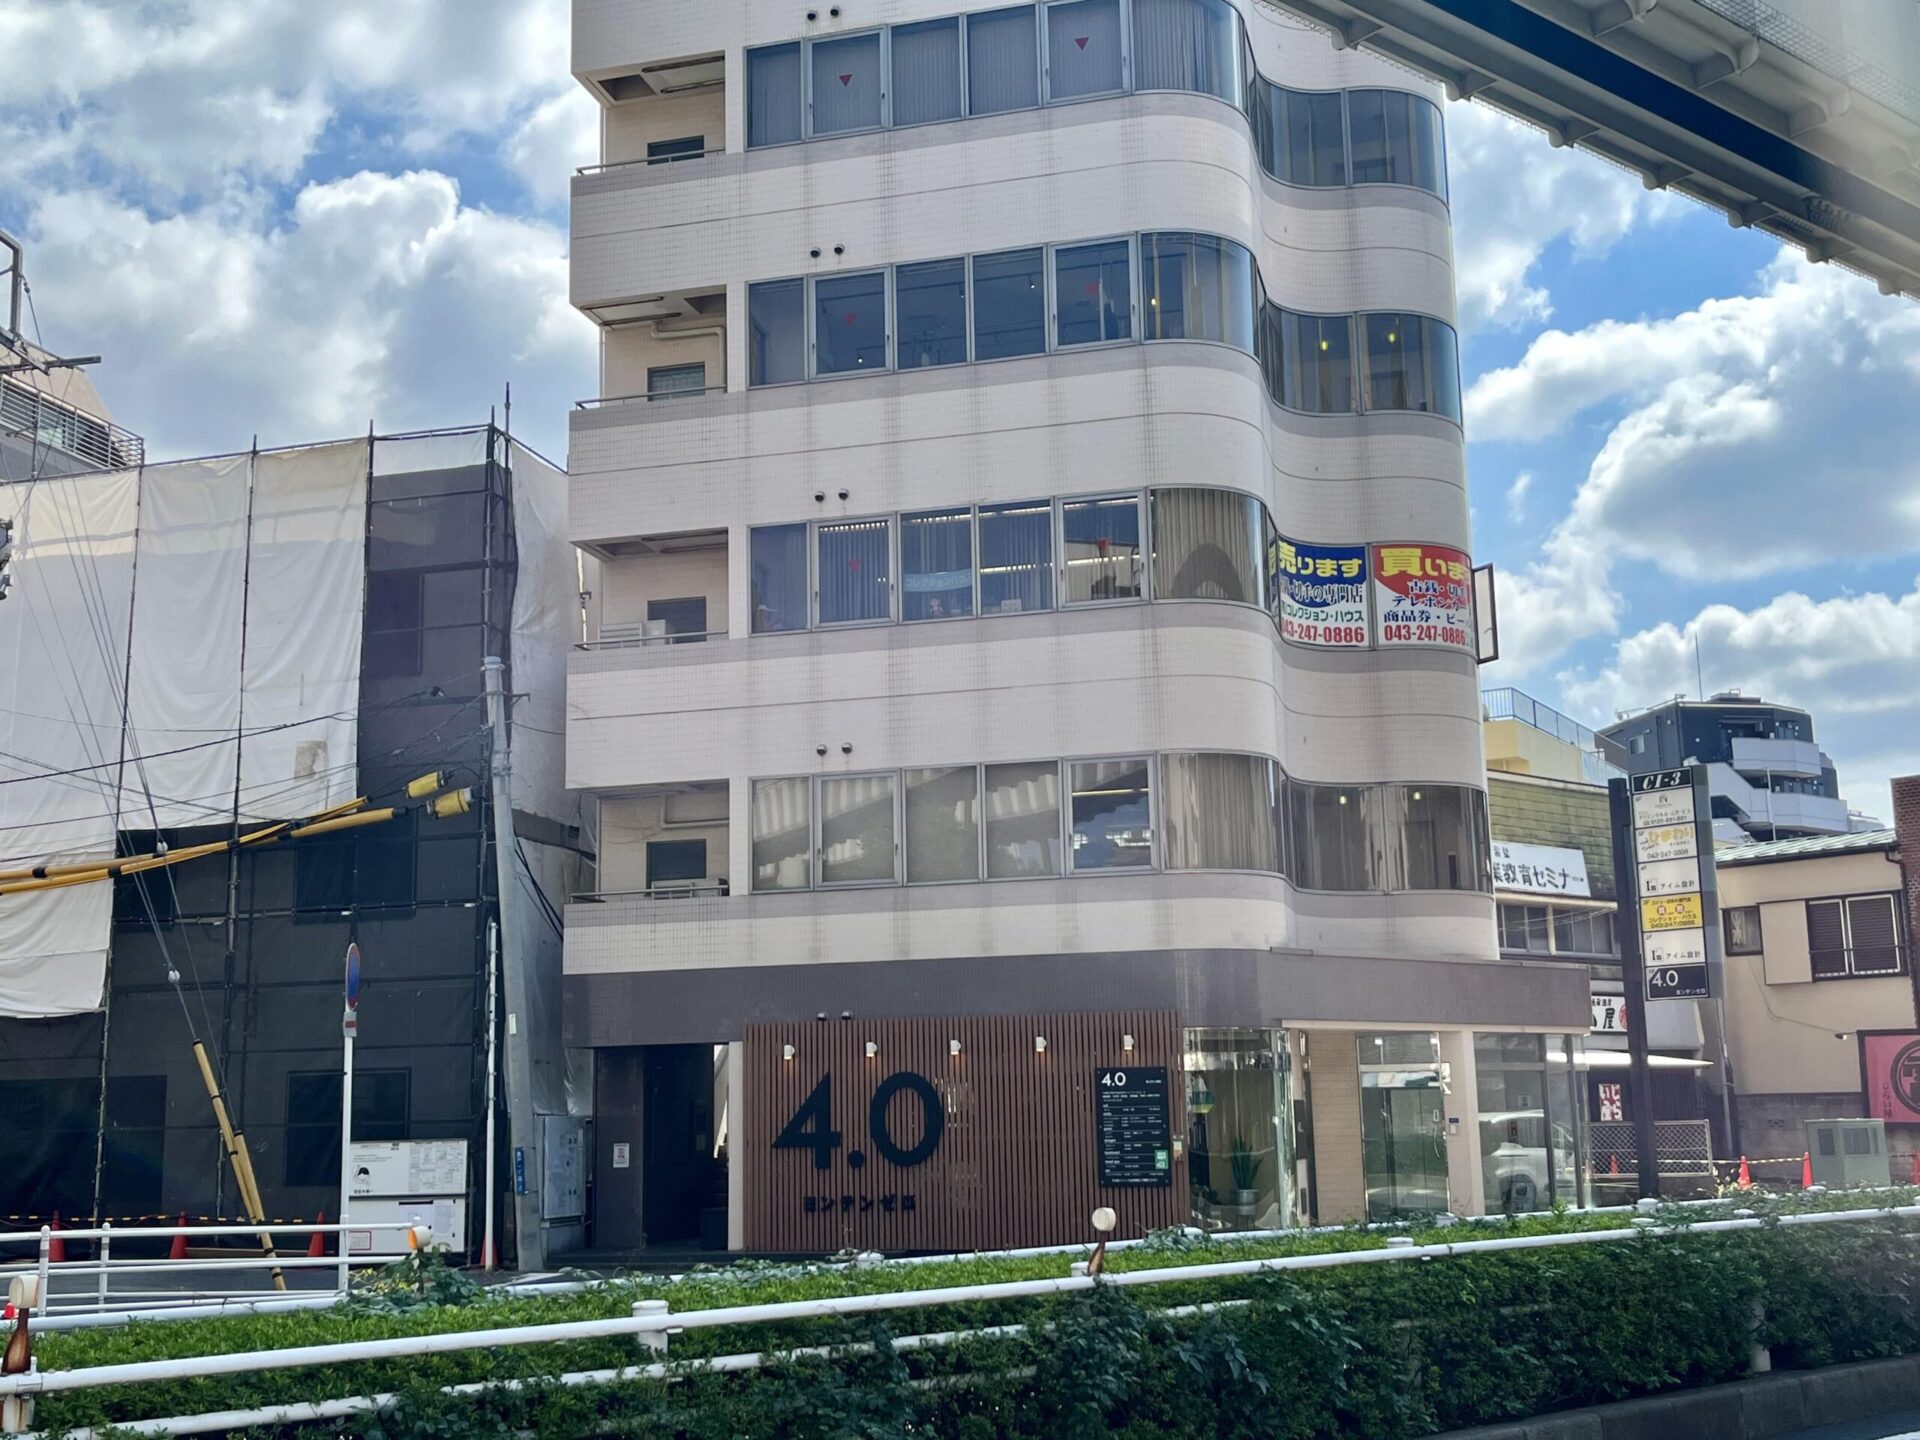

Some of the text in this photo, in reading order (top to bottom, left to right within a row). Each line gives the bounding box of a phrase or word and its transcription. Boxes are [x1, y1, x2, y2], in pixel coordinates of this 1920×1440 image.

[1279, 541, 1362, 578] 売ります
[1381, 548, 1469, 580] 買いま
[1384, 625, 1466, 645] 043-247-0886
[1651, 970, 1679, 987] 4.0
[1101, 1072, 1126, 1087] 4.0
[772, 1071, 944, 1169] 4.0
